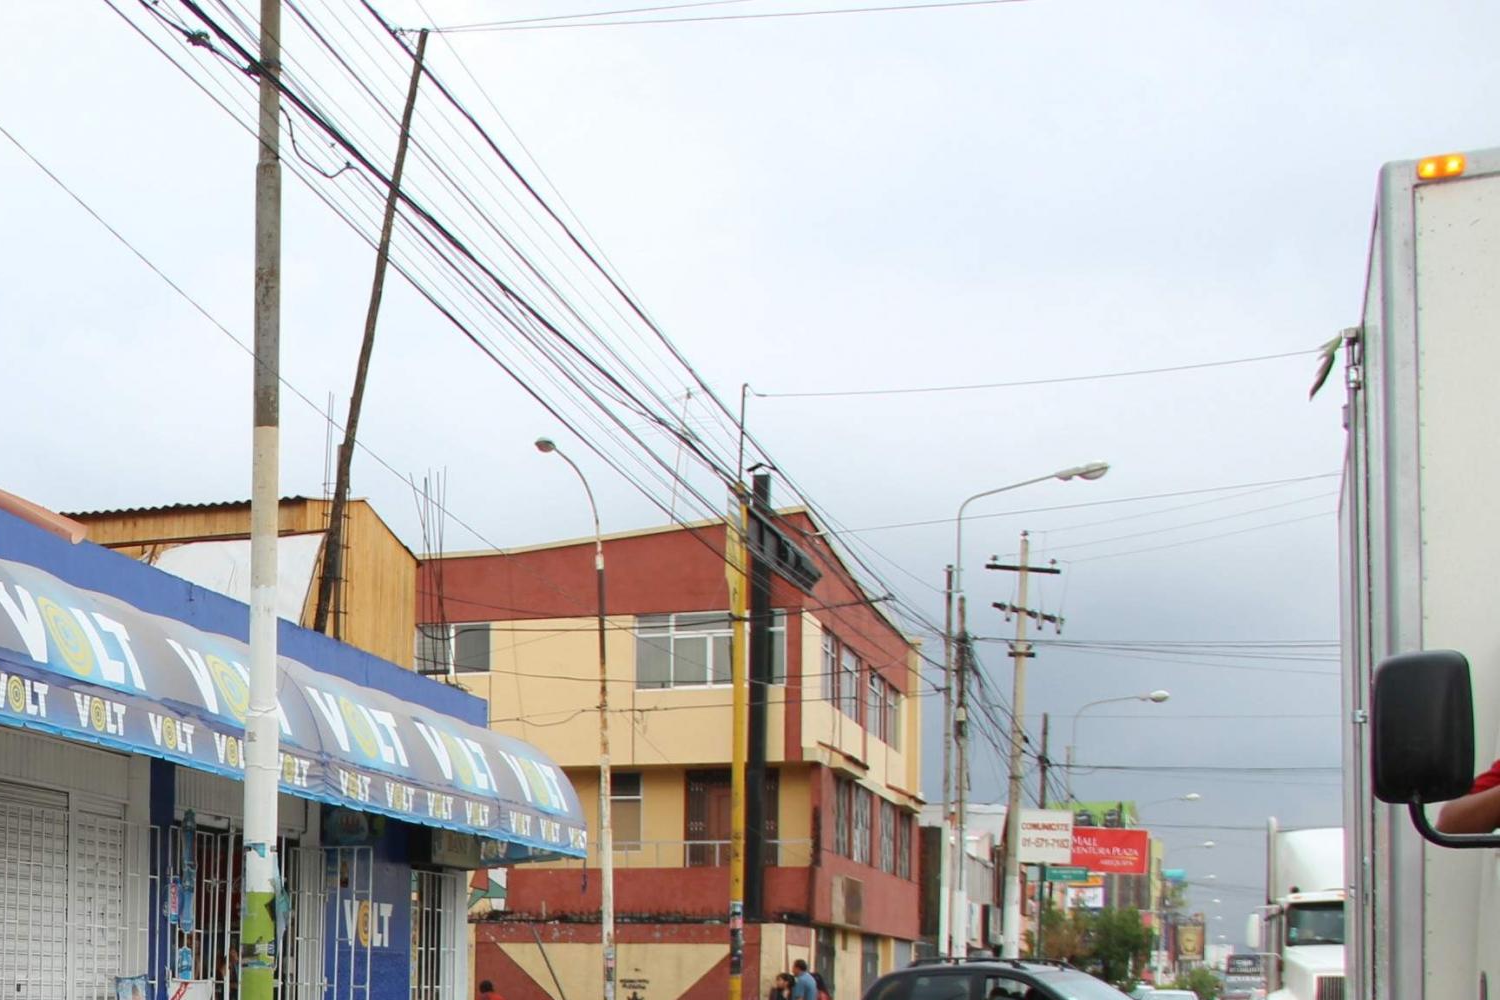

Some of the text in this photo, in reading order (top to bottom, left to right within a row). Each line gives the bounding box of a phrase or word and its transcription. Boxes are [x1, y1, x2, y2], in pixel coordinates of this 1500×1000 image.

[305, 685, 410, 768] VOLT
[414, 721, 499, 793] VOLT
[73, 691, 127, 737] VOLT
[148, 711, 196, 755] VOLT
[213, 732, 245, 770] VOL
[339, 768, 372, 803] VOLT
[385, 781, 416, 813] VOLT
[426, 791, 454, 820] VOLT
[465, 800, 490, 828] VOLT
[509, 810, 532, 837] VOLT
[539, 818, 561, 843] VOLT
[499, 750, 569, 813] VOLT
[1111, 846, 1140, 857] PLAZA
[343, 899, 393, 948] VOLT
